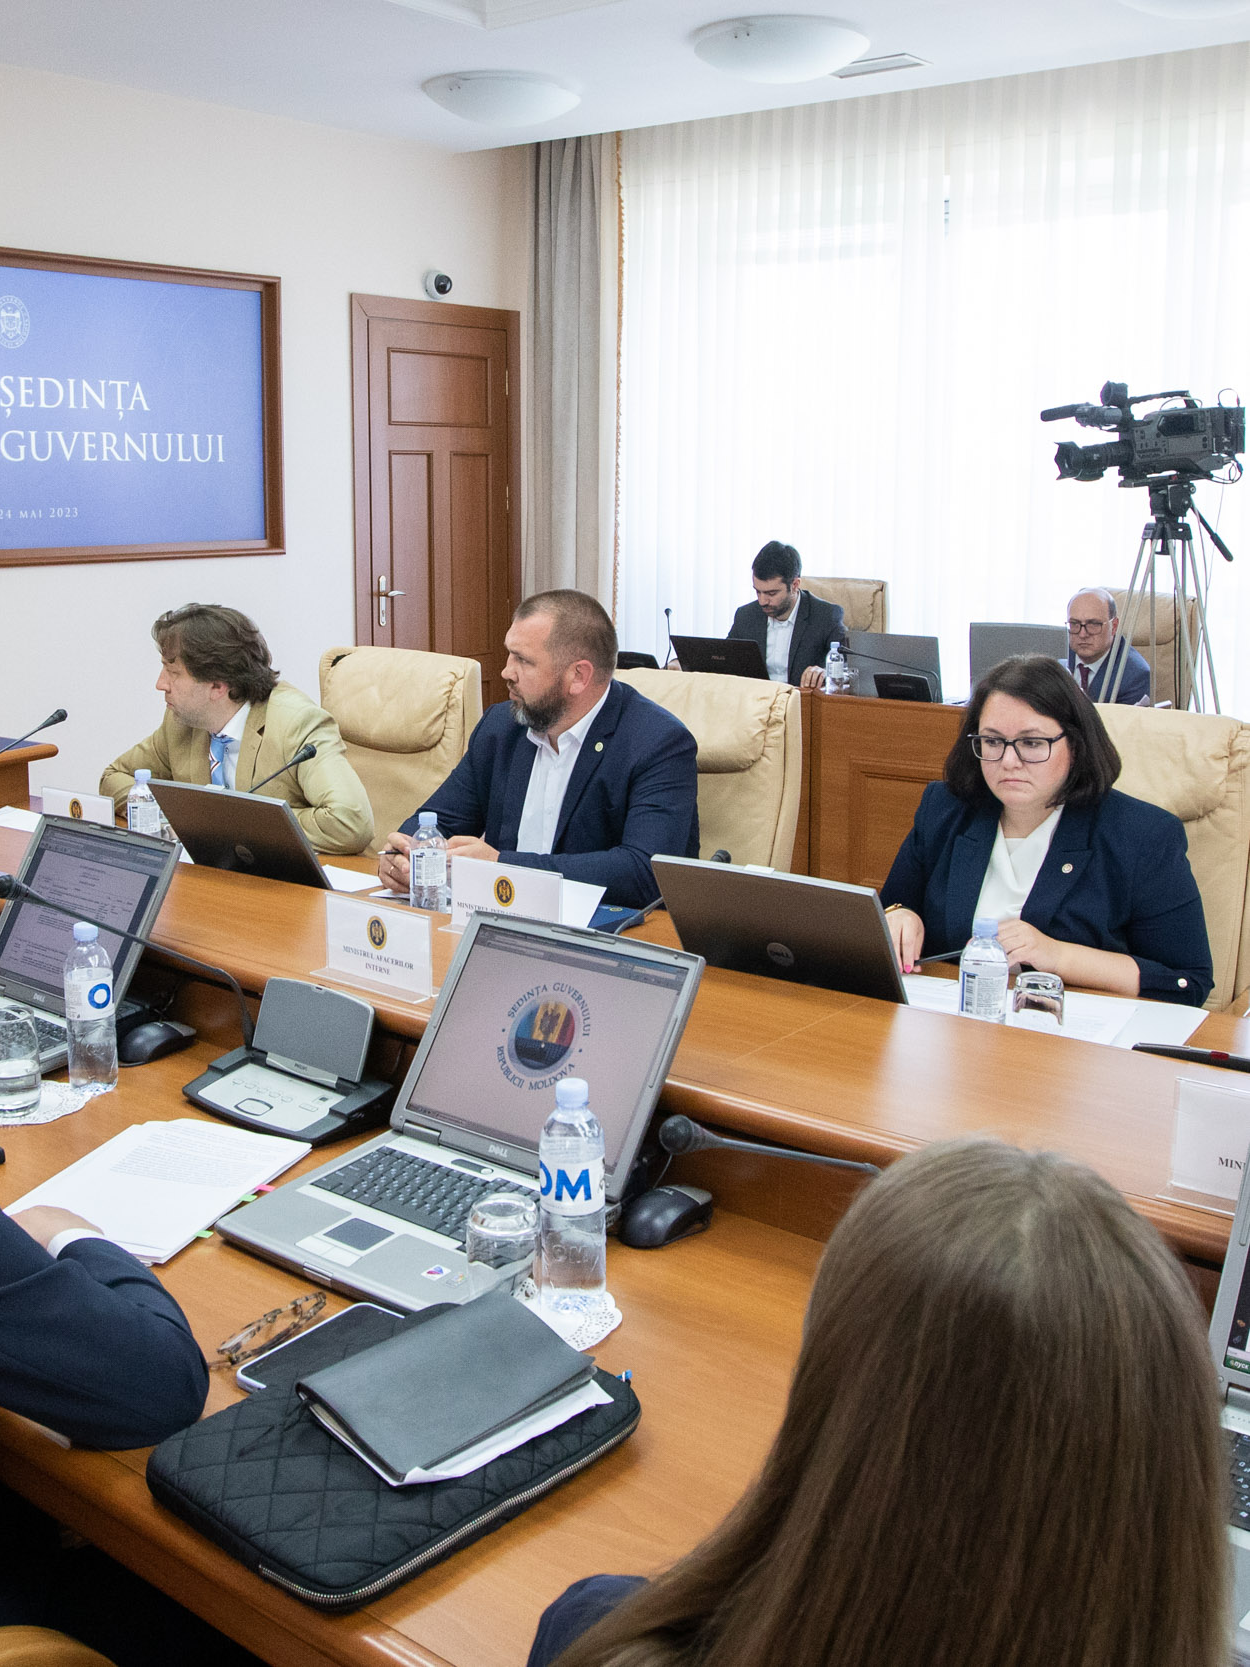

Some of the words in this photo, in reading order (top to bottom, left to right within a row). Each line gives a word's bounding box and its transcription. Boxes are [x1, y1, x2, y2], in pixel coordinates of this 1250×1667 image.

[0, 375, 150, 420] ȘEDINȚA
[0, 430, 225, 462] GUVERNULUI
[19, 509, 43, 519] MAI
[49, 507, 79, 518] 2023
[342, 945, 373, 959] MINISTRUL
[376, 955, 414, 970] AFACERILOR
[365, 962, 391, 975] INTERNE
[552, 982, 591, 1037] GUVERNULUI
[528, 1063, 575, 1090] MOLDOVA
[488, 1144, 508, 1158] DELL
